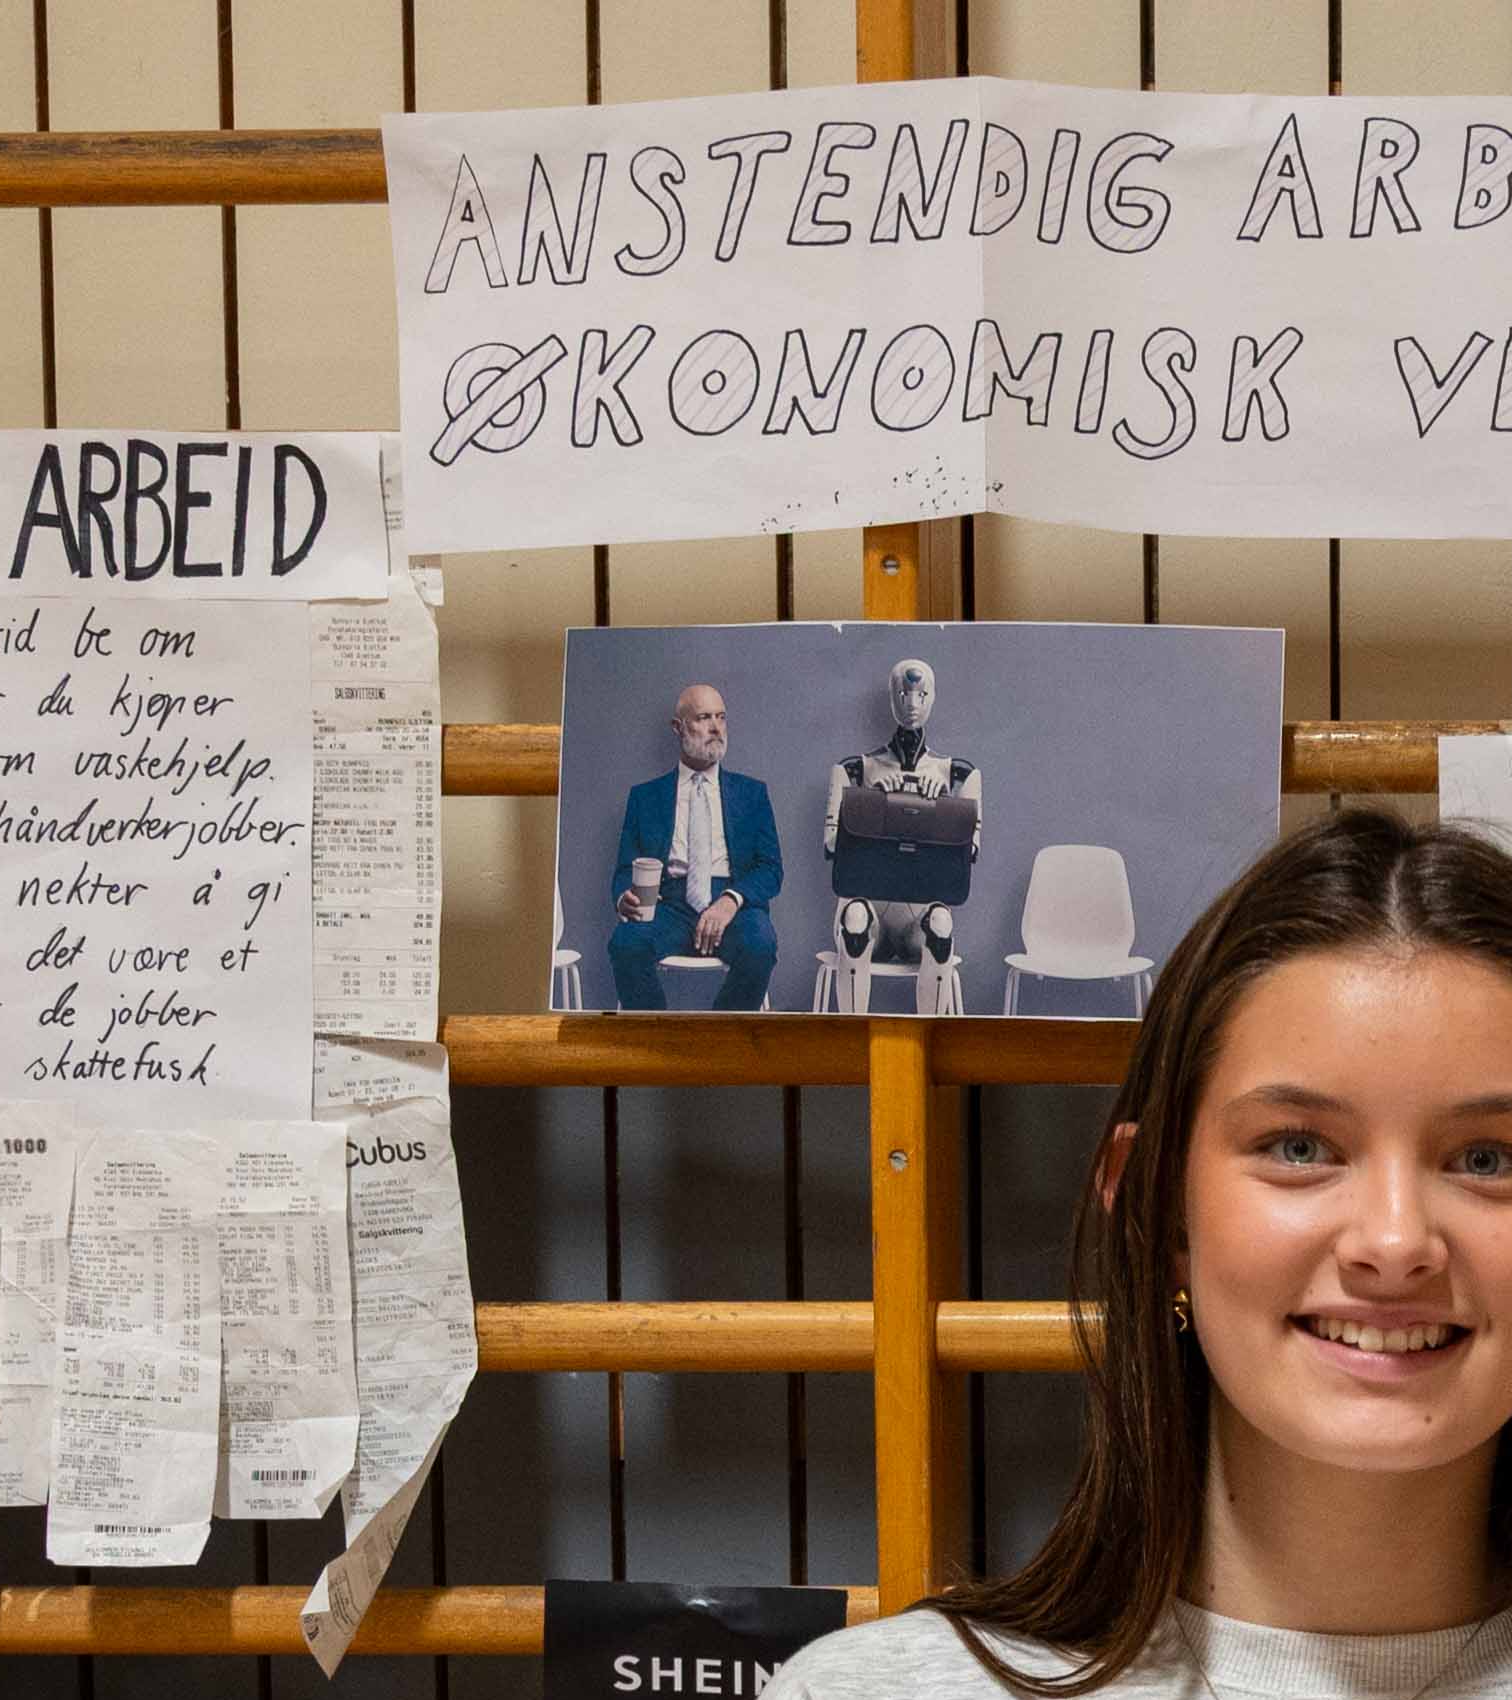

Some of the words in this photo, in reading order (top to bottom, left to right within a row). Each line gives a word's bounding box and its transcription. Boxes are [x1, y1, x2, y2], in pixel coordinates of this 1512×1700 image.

[424, 117, 1175, 296] ANSTENDIG
[429, 318, 1303, 468] ØKONOMISK
[9, 437, 326, 578] ARBEID
[74, 606, 112, 658] be
[140, 628, 195, 658] om
[37, 673, 73, 716] du
[110, 673, 234, 737] kjøper
[18, 875, 148, 912] nekter
[193, 869, 221, 905] å
[244, 872, 290, 920] gi
[26, 935, 86, 971] det
[109, 947, 189, 973] være
[220, 940, 259, 971] et
[39, 998, 79, 1027] de
[98, 989, 217, 1044] jobber
[24, 1039, 216, 1086] skattefusk
[4, 1138, 47, 1154] 1000
[346, 1136, 426, 1168] Cubus
